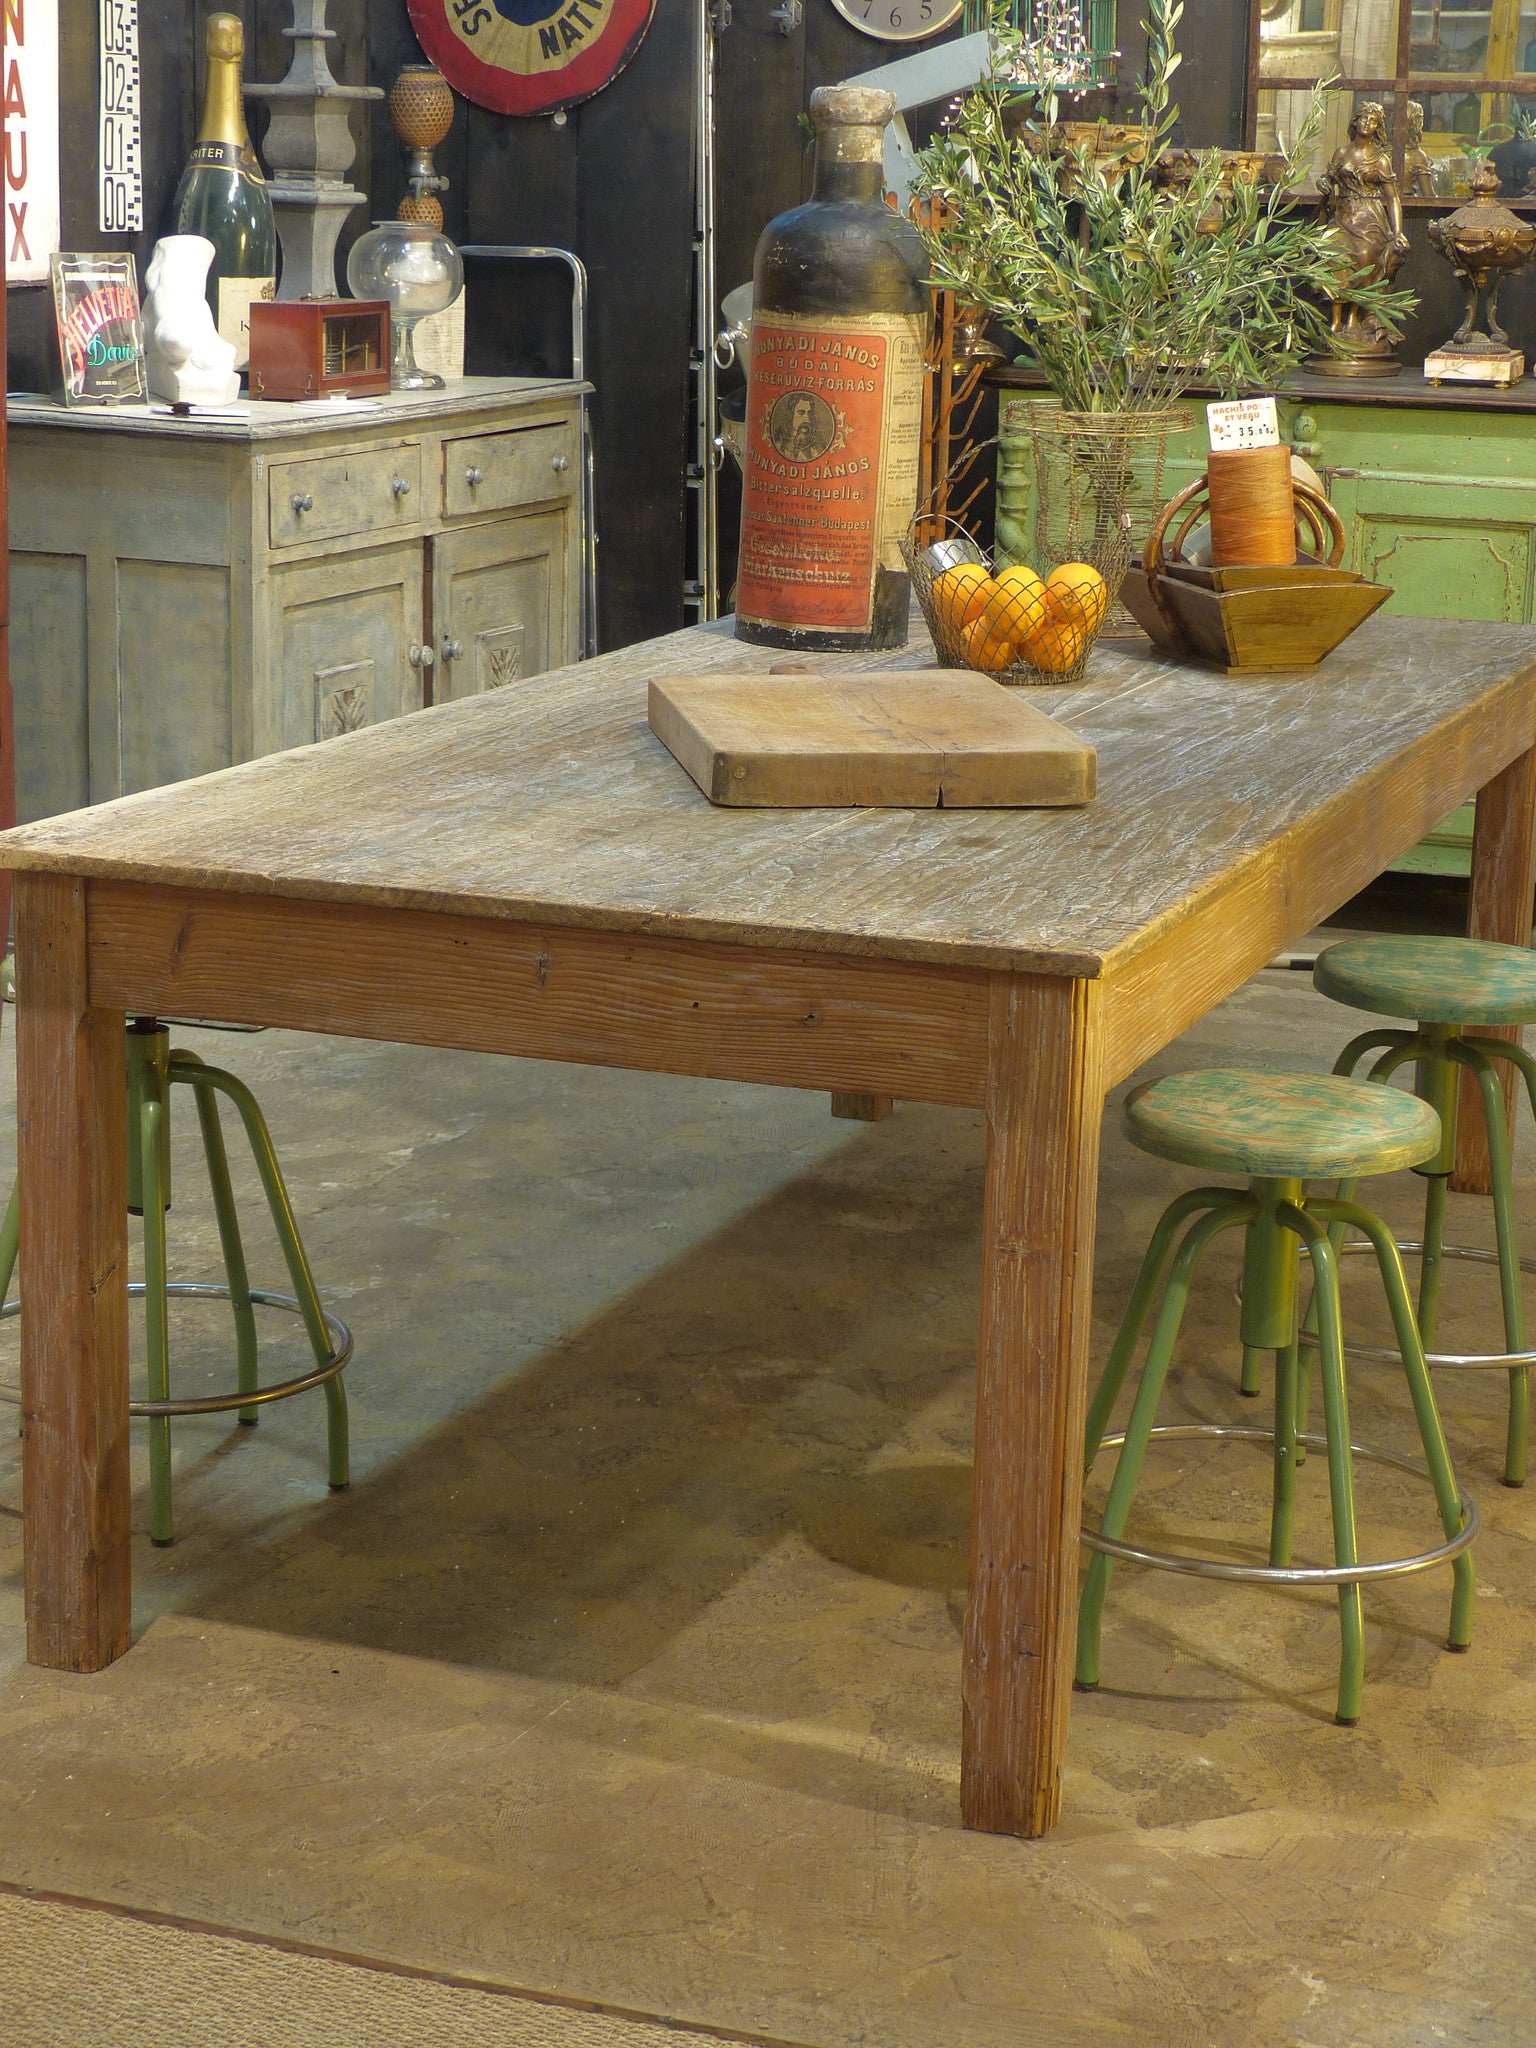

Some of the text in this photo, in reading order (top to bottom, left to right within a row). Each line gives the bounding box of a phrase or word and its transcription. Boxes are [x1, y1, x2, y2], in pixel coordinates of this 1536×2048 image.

[890, 6, 901, 27] 6
[105, 56, 126, 112] 02
[105, 116, 123, 171] 01
[104, 176, 126, 230] 00
[63, 286, 136, 371] HELVETIA
[820, 338, 880, 370] JÁNOS
[818, 376, 876, 393] FORRÁS
[1212, 406, 1244, 415] HACHIS
[1236, 412, 1260, 420] VEAU
[811, 457, 871, 480] JÁNOS
[820, 515, 872, 534] Budapest
